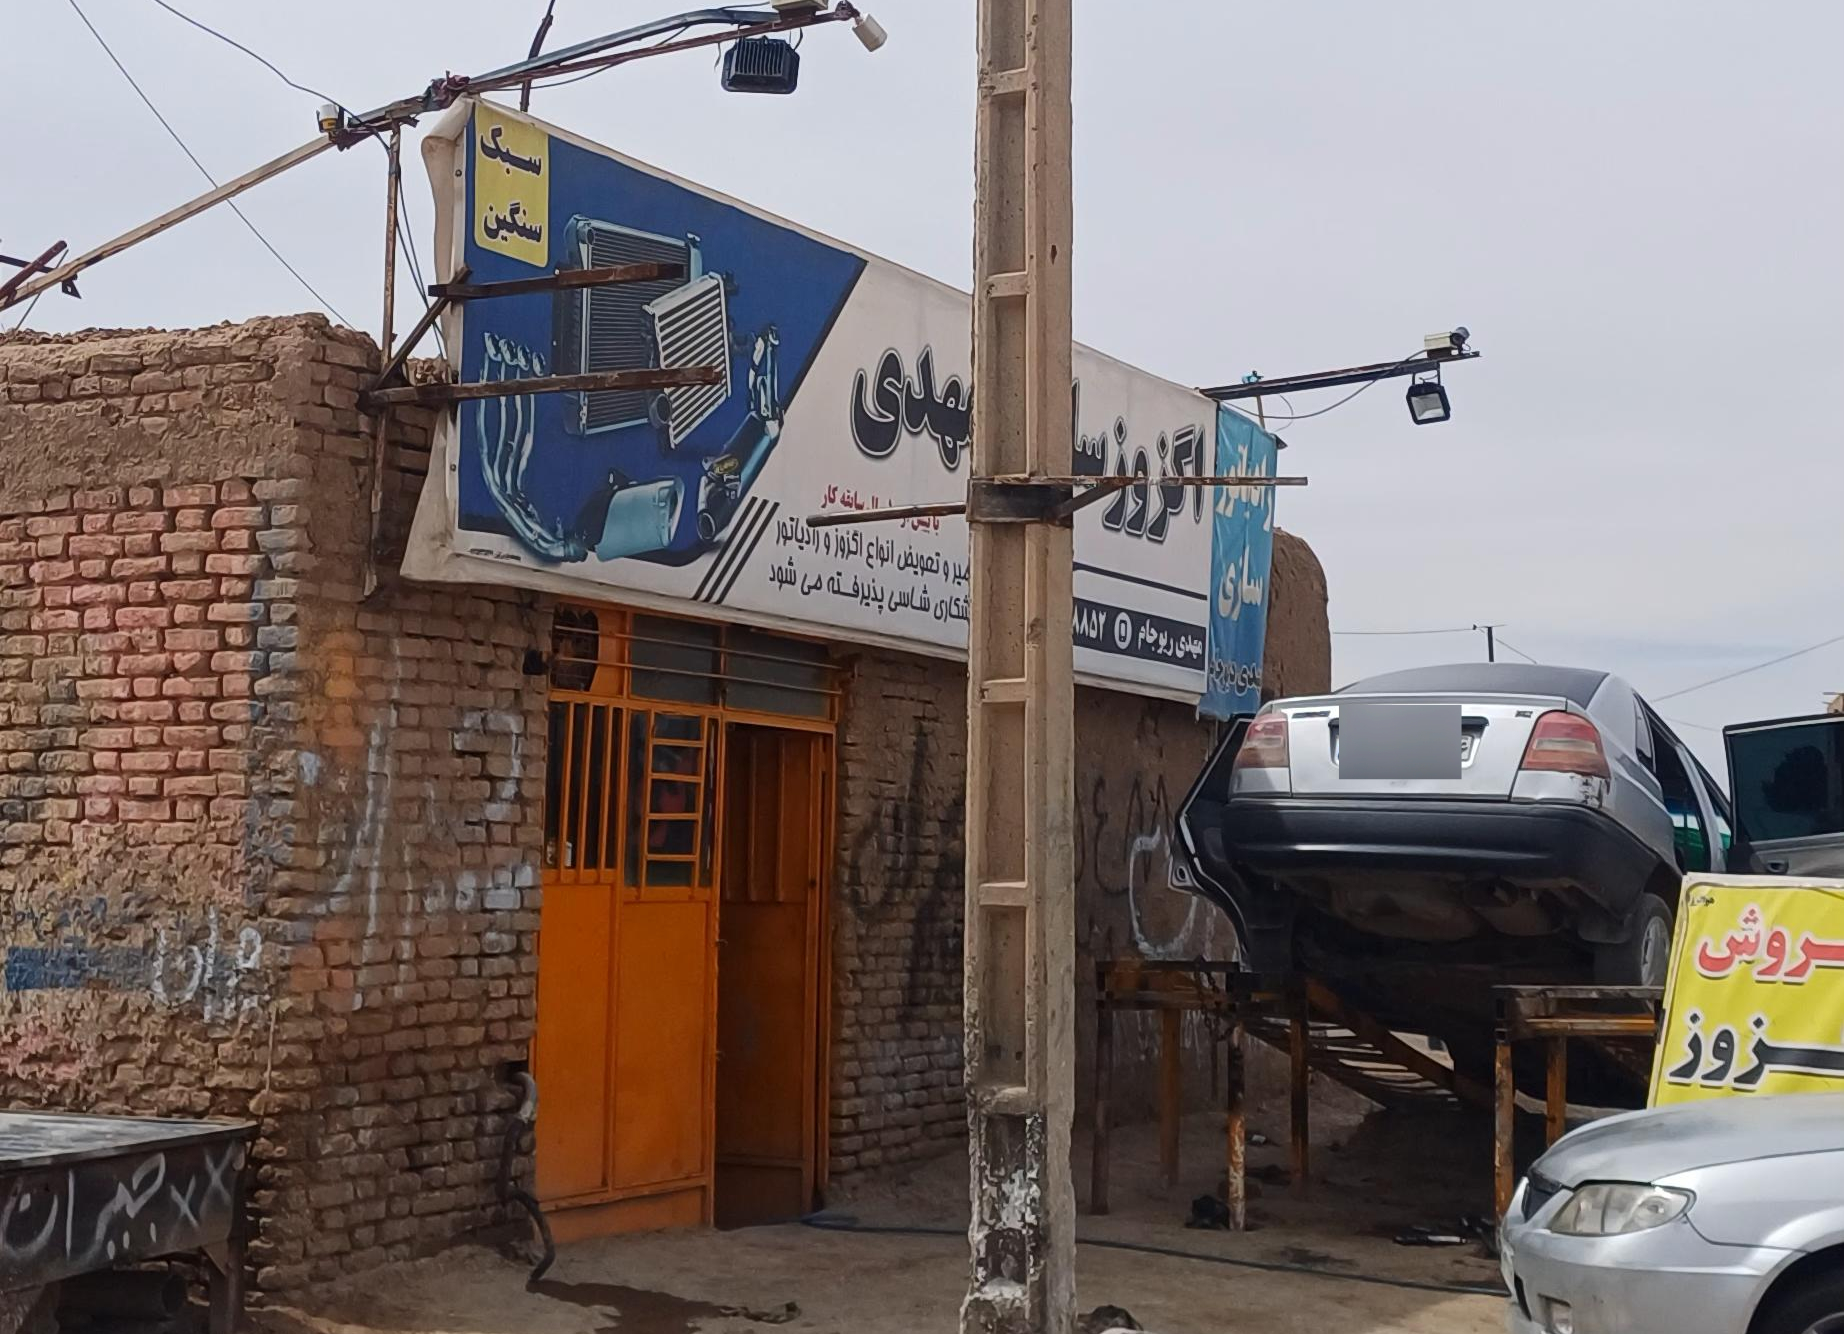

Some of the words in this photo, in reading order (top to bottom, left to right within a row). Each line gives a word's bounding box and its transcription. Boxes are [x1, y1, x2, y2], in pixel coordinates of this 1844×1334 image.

[480, 127, 542, 175] سبک
[484, 201, 543, 243] سنگین
[1072, 378, 1108, 482] سا
[821, 484, 839, 508] کار
[1103, 417, 1206, 541] اگزوز
[776, 517, 820, 553] رادیاتور
[824, 536, 831, 555] و
[834, 528, 863, 560] اگزوز
[866, 536, 895, 569] انواع
[897, 545, 940, 577] تعویض
[769, 556, 797, 591] شود
[801, 574, 823, 595] می
[943, 559, 950, 582] و
[1218, 545, 1264, 622] سازی
[827, 571, 885, 615] پذیرفته
[888, 584, 931, 613] شاسی
[933, 593, 969, 623] شکاری
[1176, 635, 1203, 659] مهدی
[1698, 908, 1844, 980] روش
[1668, 1012, 1844, 1086] زوز
